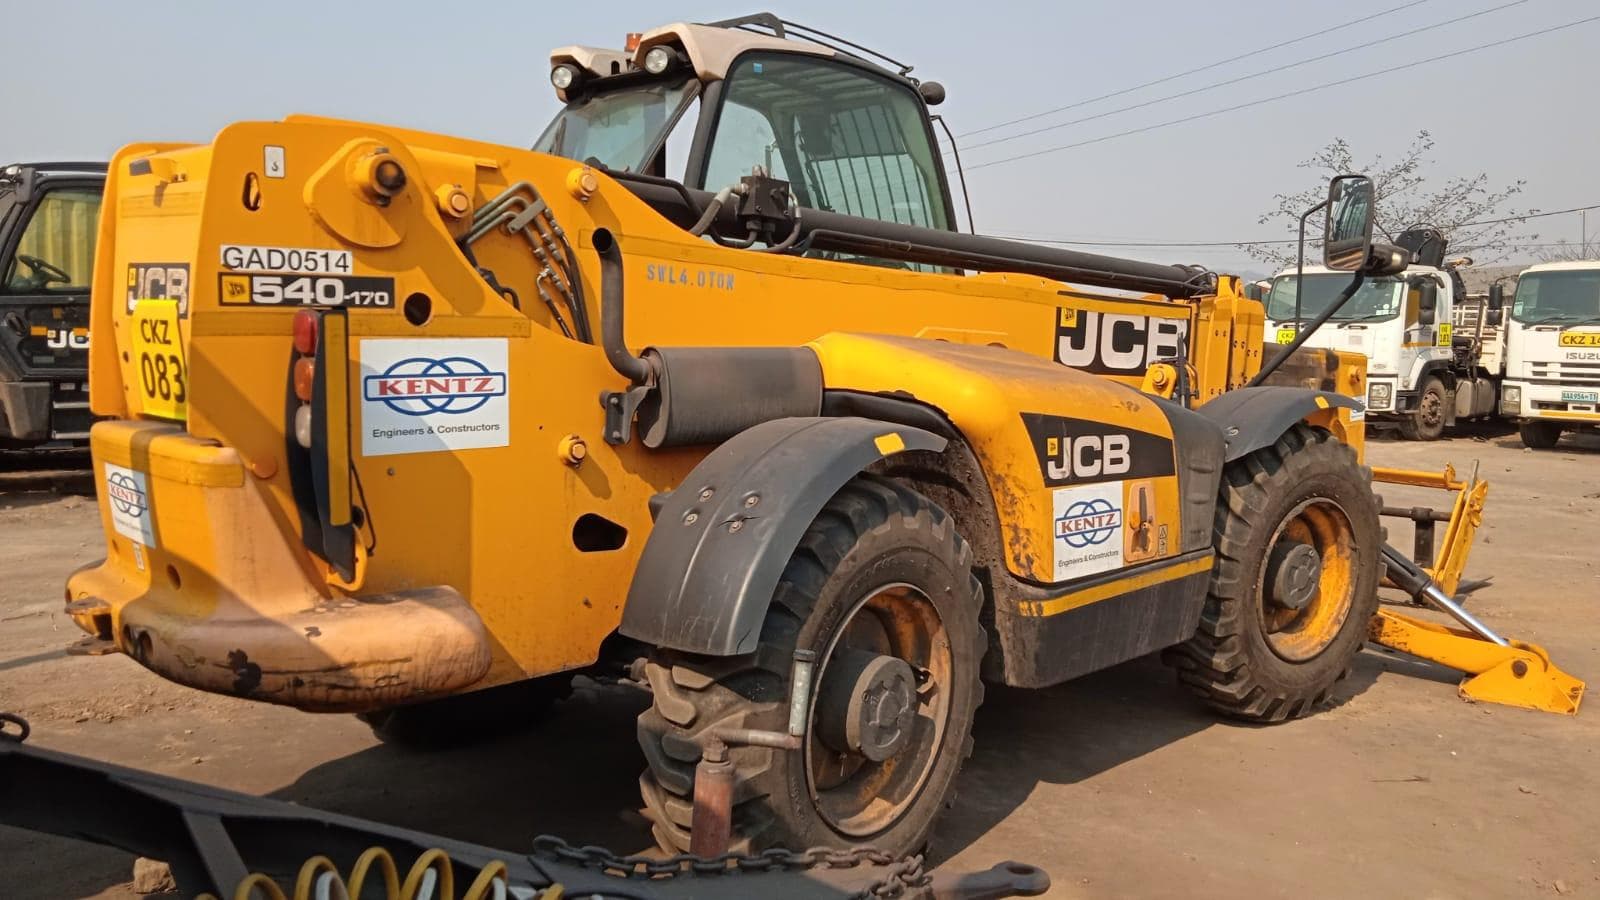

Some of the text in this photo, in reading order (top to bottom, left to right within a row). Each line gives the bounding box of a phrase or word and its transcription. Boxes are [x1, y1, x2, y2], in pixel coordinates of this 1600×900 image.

[222, 246, 350, 273] GAD0514
[252, 275, 390, 306] 540-170
[140, 318, 172, 345] CKZ
[1058, 310, 1189, 370] JCB
[1562, 335, 1586, 345] CKZ
[141, 351, 187, 404] 083
[378, 377, 496, 397] KENTZ
[372, 422, 500, 439] Engineers & Constructors
[1047, 434, 1131, 480] JCB
[1061, 513, 1117, 534] KENTZ
[1058, 556, 1083, 568] Engineers
[1088, 550, 1119, 561] Constructors
